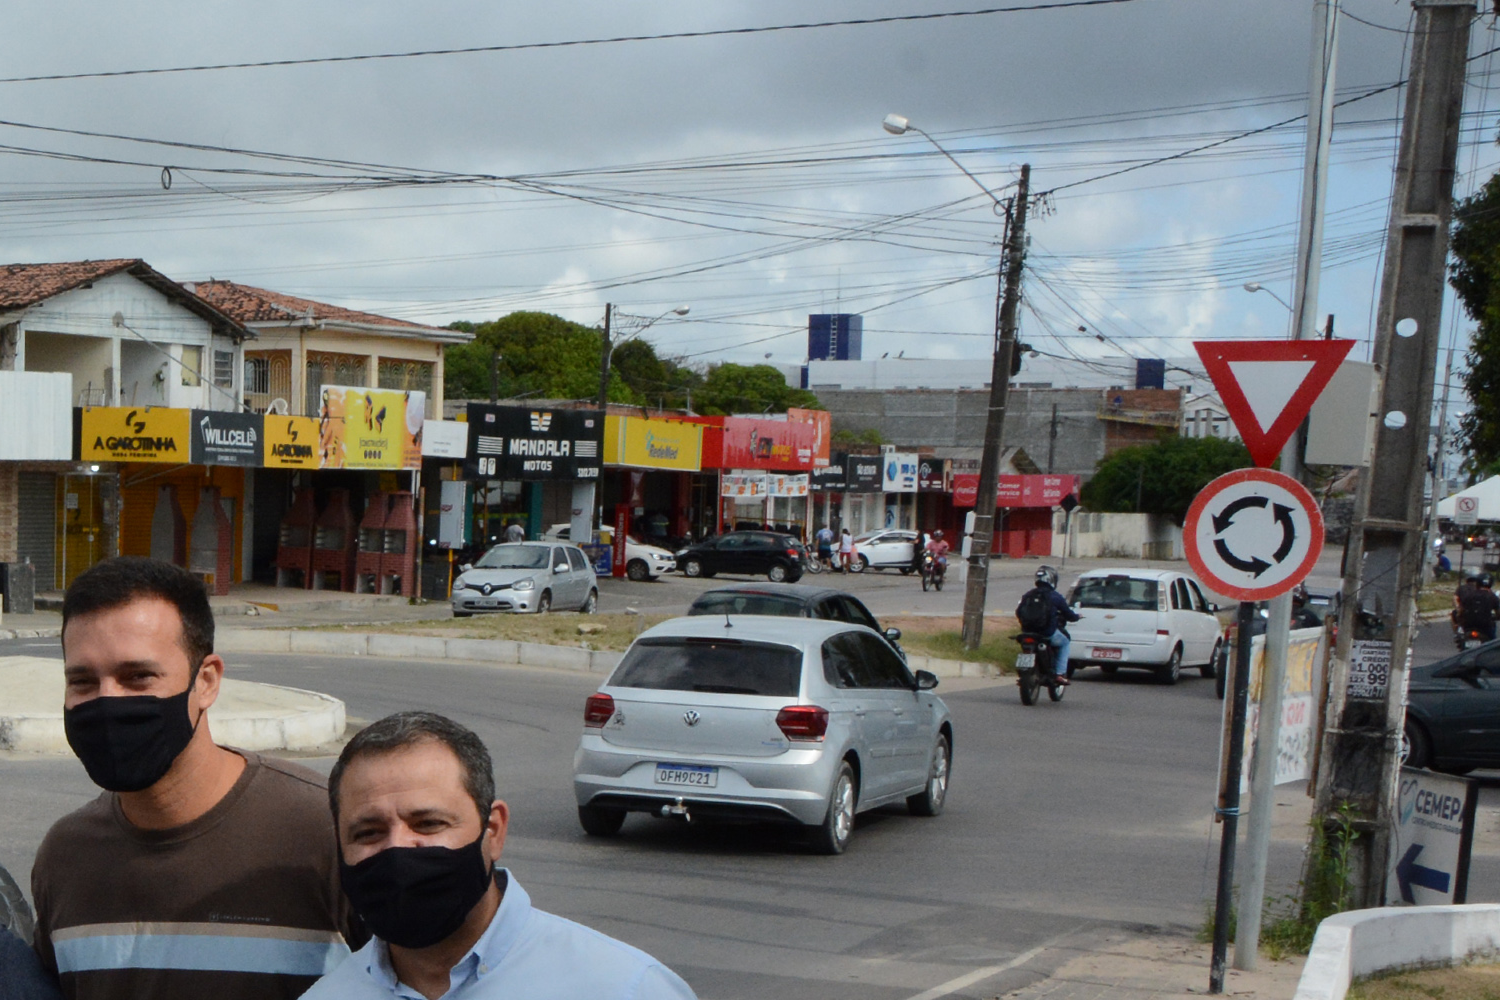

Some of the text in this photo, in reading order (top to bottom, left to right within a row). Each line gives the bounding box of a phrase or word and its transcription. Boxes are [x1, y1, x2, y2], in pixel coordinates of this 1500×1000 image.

[93, 436, 105, 450] A
[205, 429, 254, 447] WILLCELL
[509, 438, 571, 457] MANDALA
[523, 460, 553, 471] MOTOS
[660, 770, 711, 785] OFH9C21
